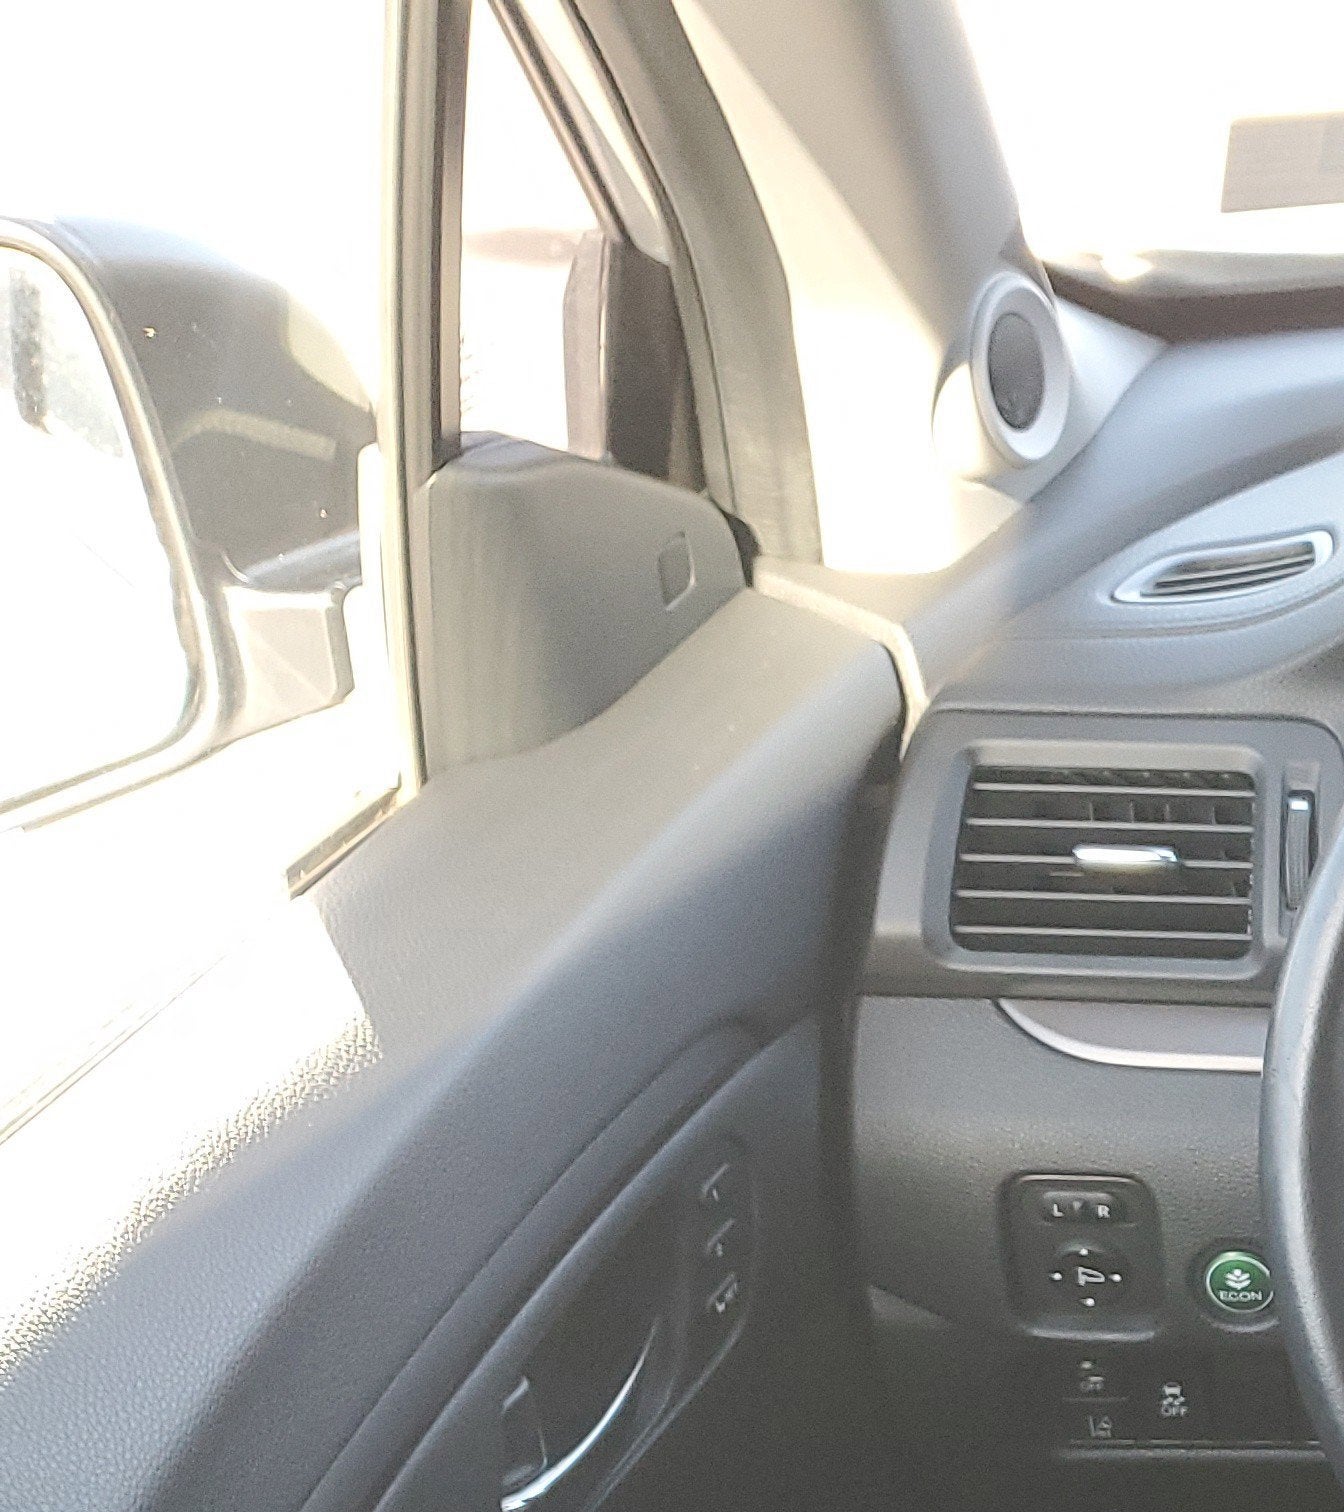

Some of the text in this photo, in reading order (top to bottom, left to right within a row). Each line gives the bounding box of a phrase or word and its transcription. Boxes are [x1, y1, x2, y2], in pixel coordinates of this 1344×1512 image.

[1052, 1204, 1065, 1218] L
[1097, 1205, 1111, 1219] R
[1220, 1290, 1263, 1302] ECON
